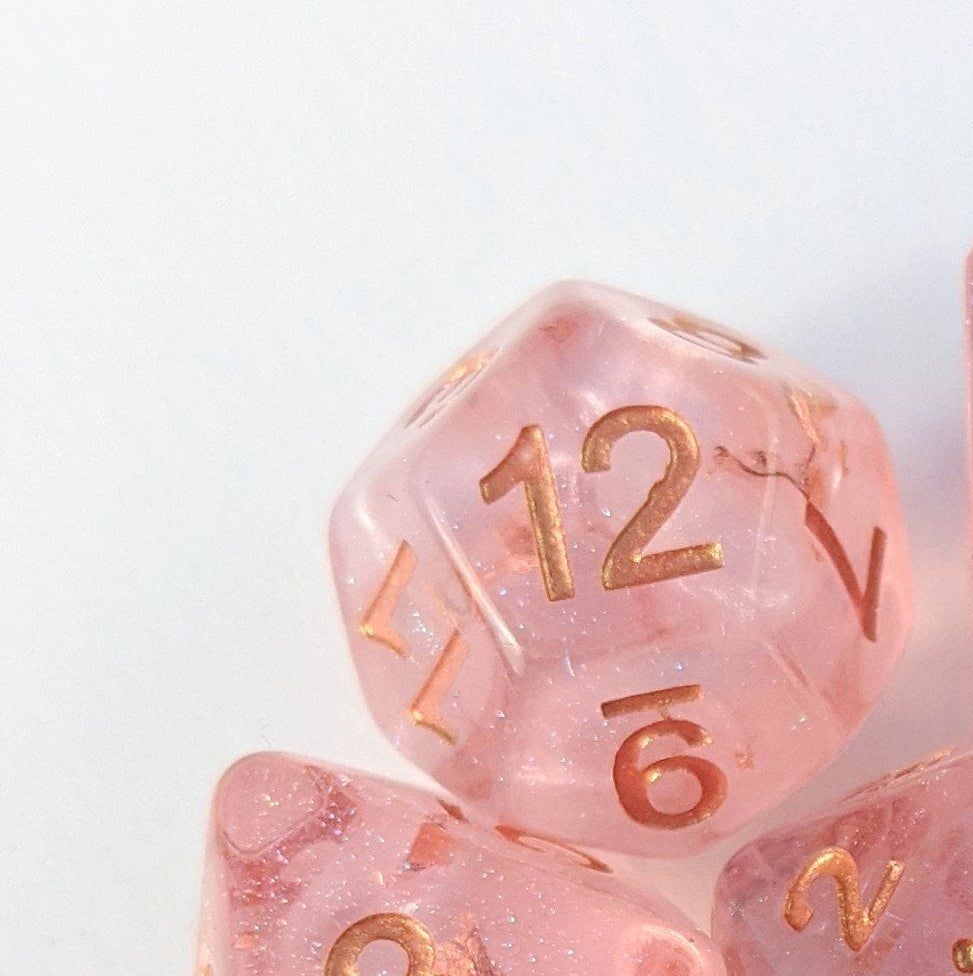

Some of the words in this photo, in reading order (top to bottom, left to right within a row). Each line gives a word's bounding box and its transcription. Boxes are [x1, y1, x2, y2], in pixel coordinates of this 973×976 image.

[479, 404, 724, 602] 12
[612, 719, 728, 831] 6
[783, 847, 905, 952] 2
